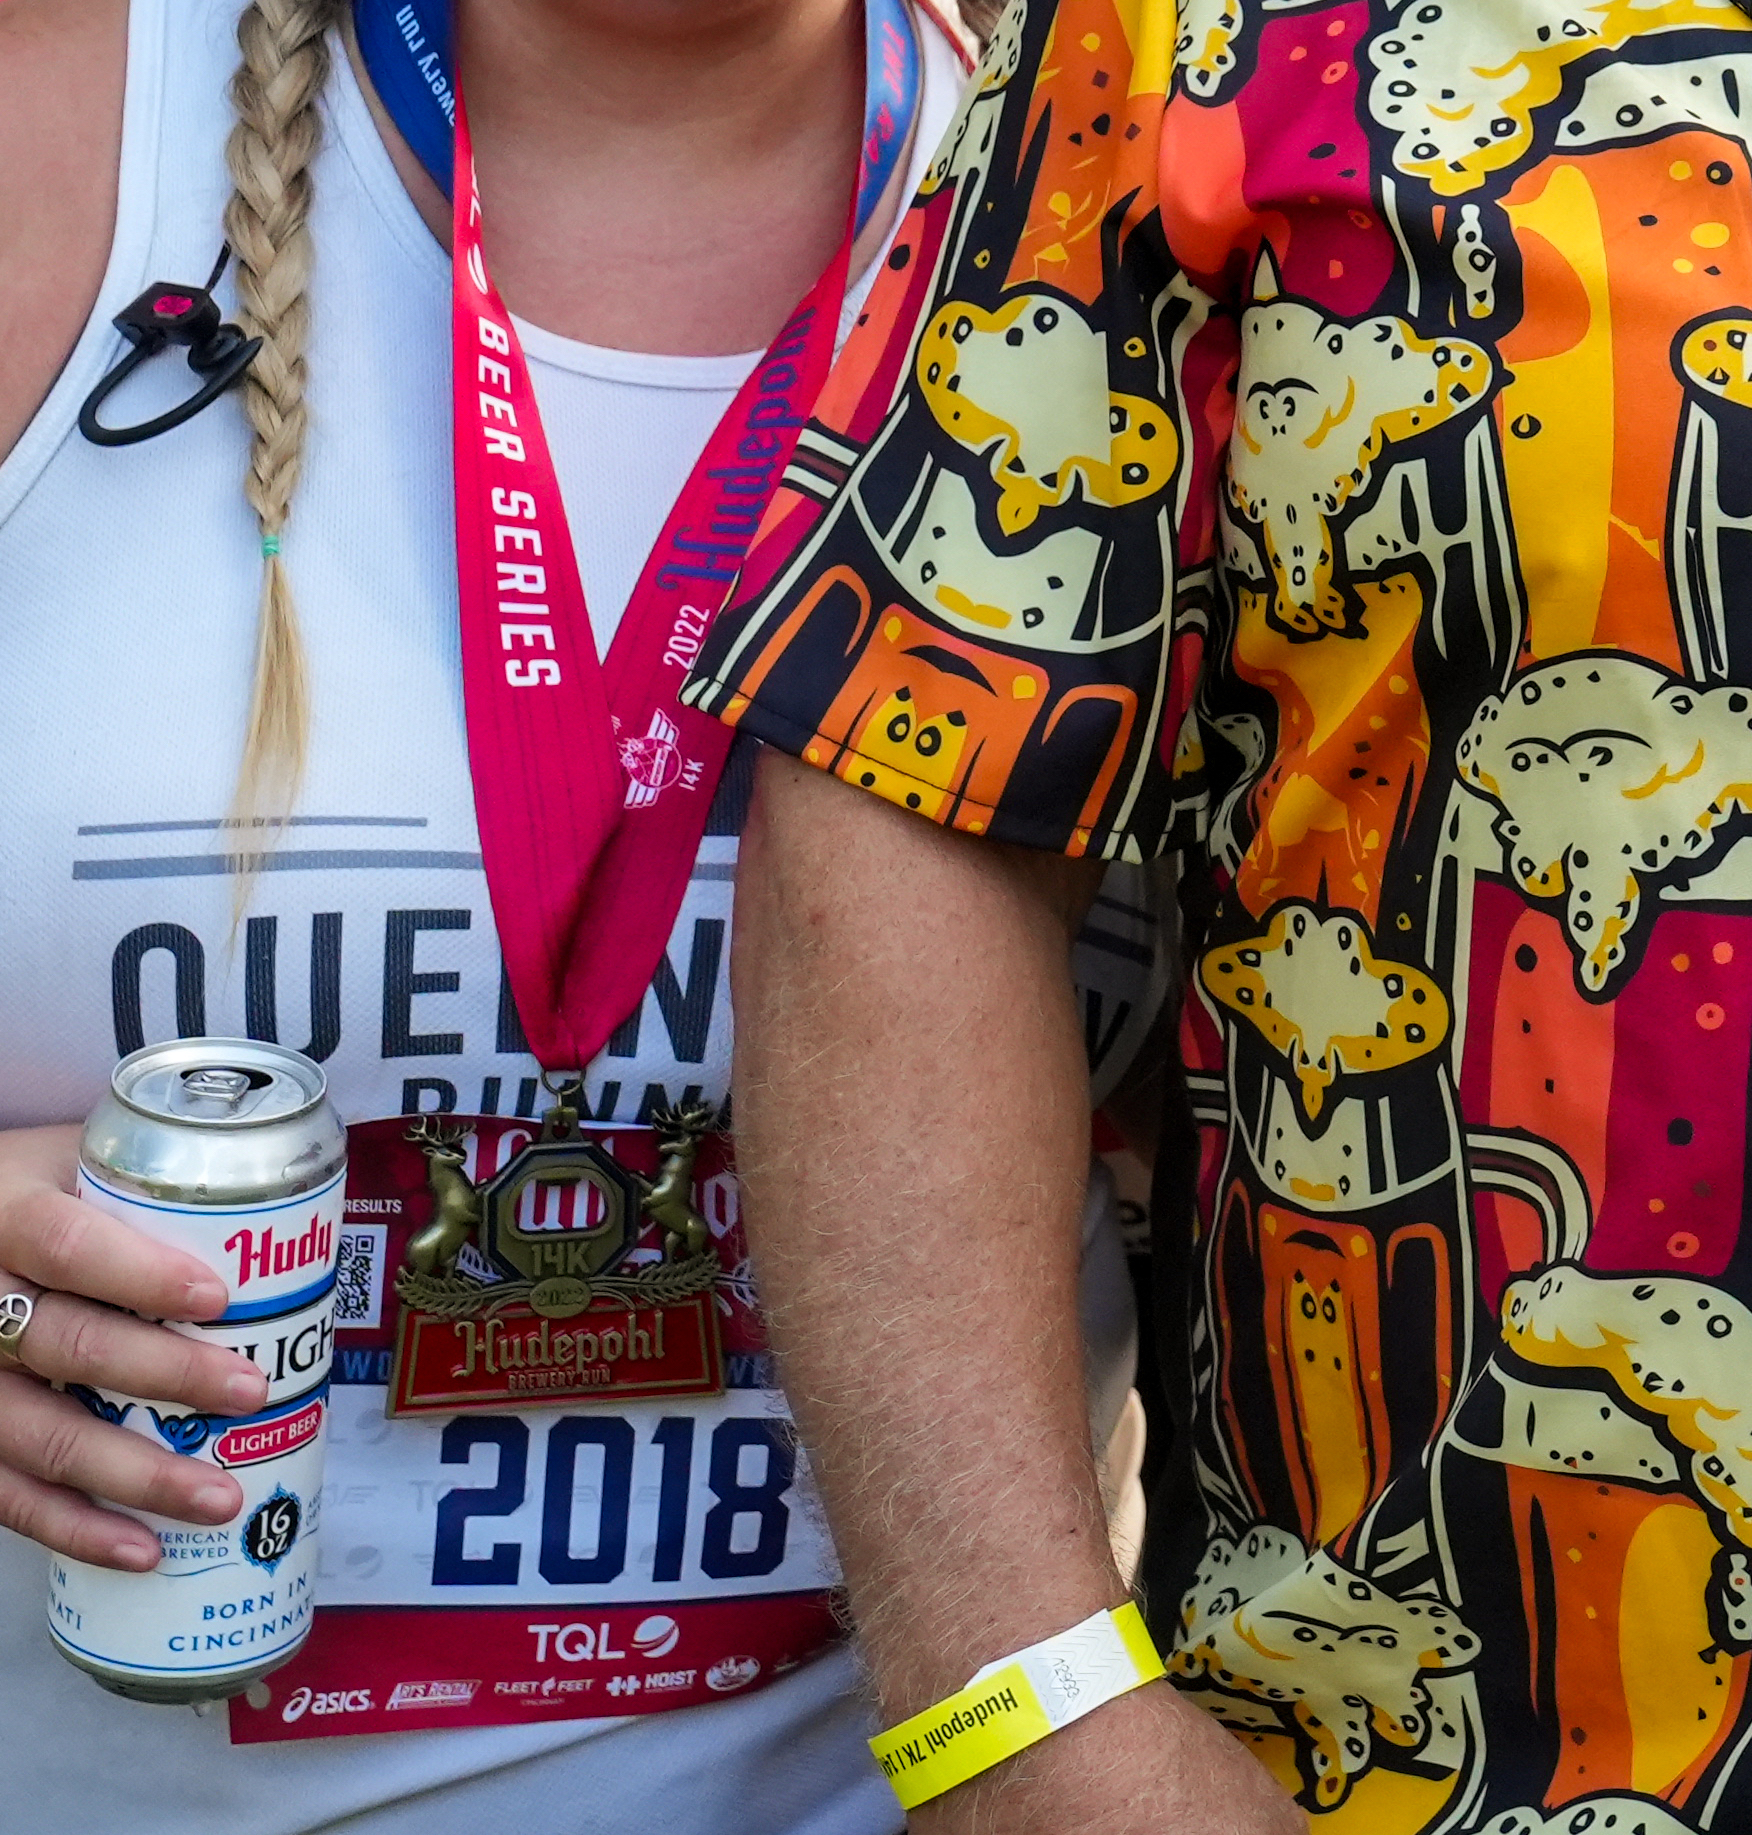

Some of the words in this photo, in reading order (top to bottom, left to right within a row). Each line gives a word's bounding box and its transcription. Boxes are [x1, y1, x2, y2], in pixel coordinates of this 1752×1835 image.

[396, 4, 426, 52] run
[477, 314, 526, 463] BEER
[491, 486, 563, 689] SERIES
[663, 605, 711, 671] 2022
[679, 758, 705, 791] 14K
[223, 1211, 331, 1289] Hudy
[531, 1241, 593, 1277] 14K
[451, 1311, 667, 1378] Hudepohl
[507, 1370, 577, 1392] BREWERY
[582, 1367, 611, 1386] RUN
[229, 1428, 285, 1456] LIGHT
[288, 1411, 318, 1441] BEER
[260, 1501, 291, 1537] 16
[432, 1415, 797, 1586] 2018
[257, 1536, 288, 1559] OZ
[203, 1591, 275, 1622] BORN
[288, 1572, 308, 1598] IN
[527, 1622, 627, 1662] TQL
[494, 1681, 540, 1695] FLEET
[558, 1677, 594, 1692] FEET
[645, 1669, 697, 1690] HOIST
[924, 1687, 1019, 1754] Hudepohl
[902, 1739, 927, 1768] 7K
